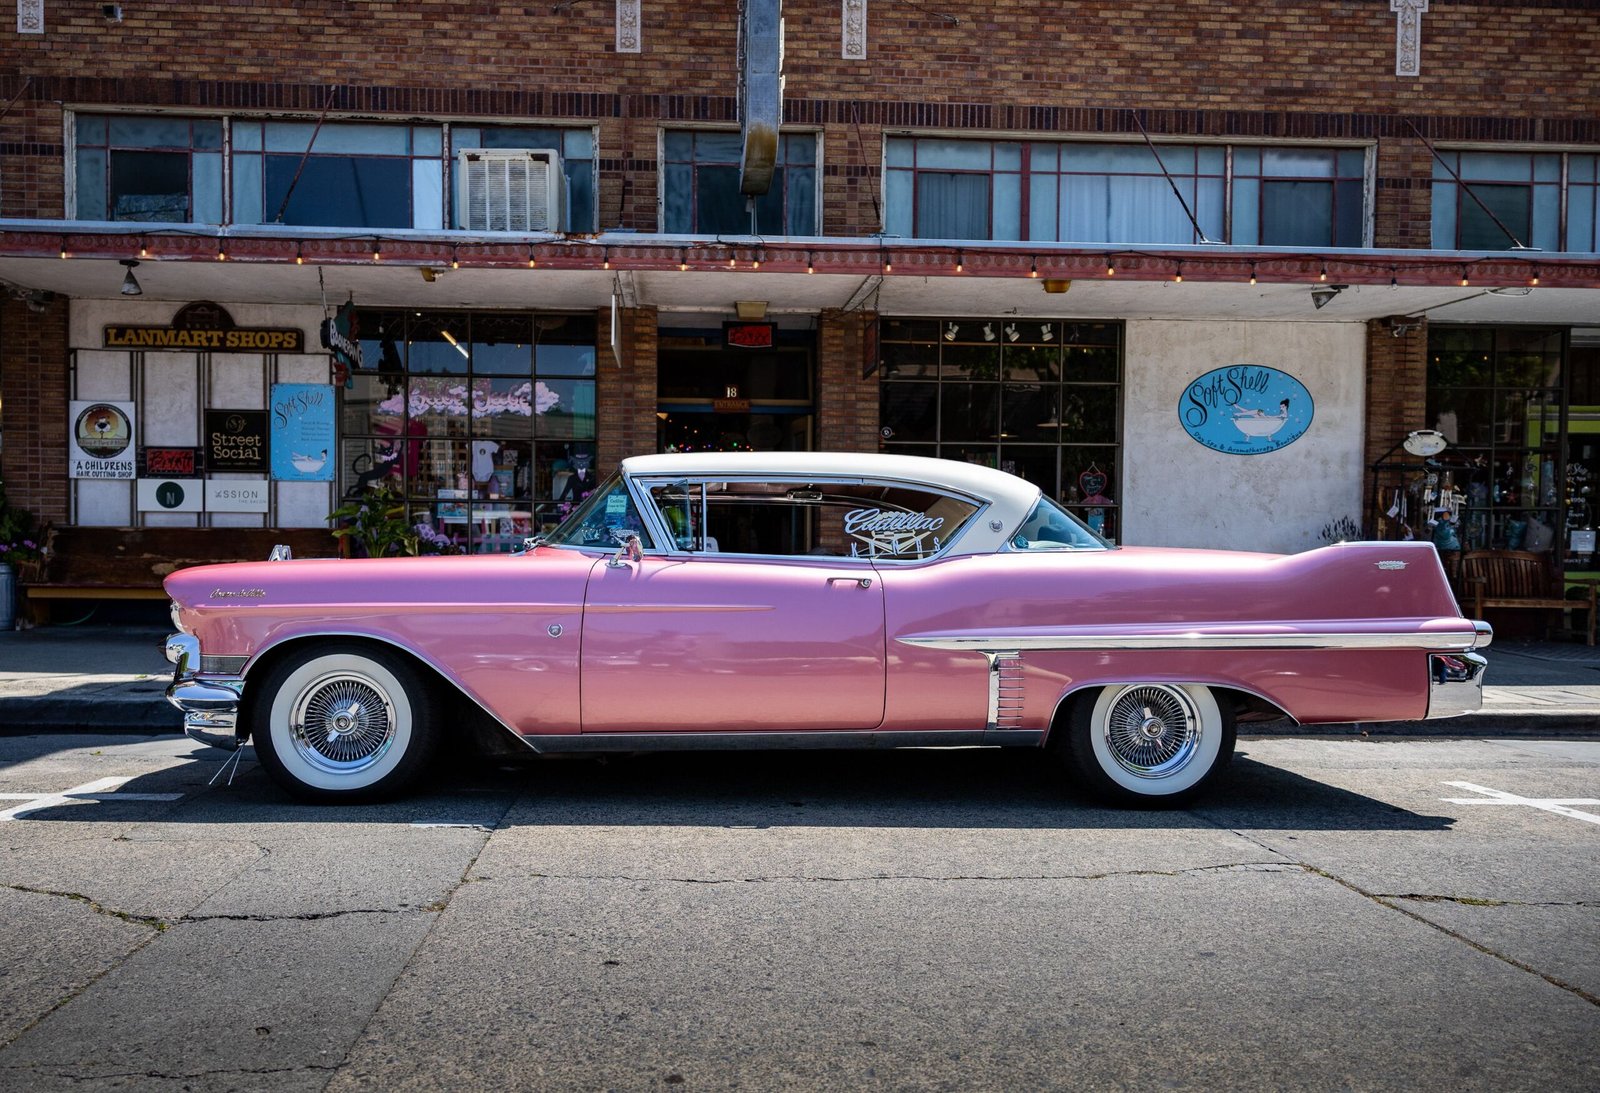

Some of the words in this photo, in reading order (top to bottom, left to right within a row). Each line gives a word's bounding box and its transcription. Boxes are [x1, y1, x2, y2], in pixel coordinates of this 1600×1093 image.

[107, 328, 224, 346] LANMART
[226, 330, 297, 348] SHOPS
[726, 386, 737, 398] 18
[1186, 373, 1226, 428] Soft
[1224, 366, 1270, 406] Shell
[211, 431, 262, 447] Street
[213, 446, 262, 460] Social
[76, 460, 83, 470] A
[85, 461, 133, 471] CHILDRENS
[76, 470, 90, 478] HAIR
[91, 470, 116, 478] CUTTING
[166, 492, 175, 505] N
[844, 508, 944, 534] Cadillac
